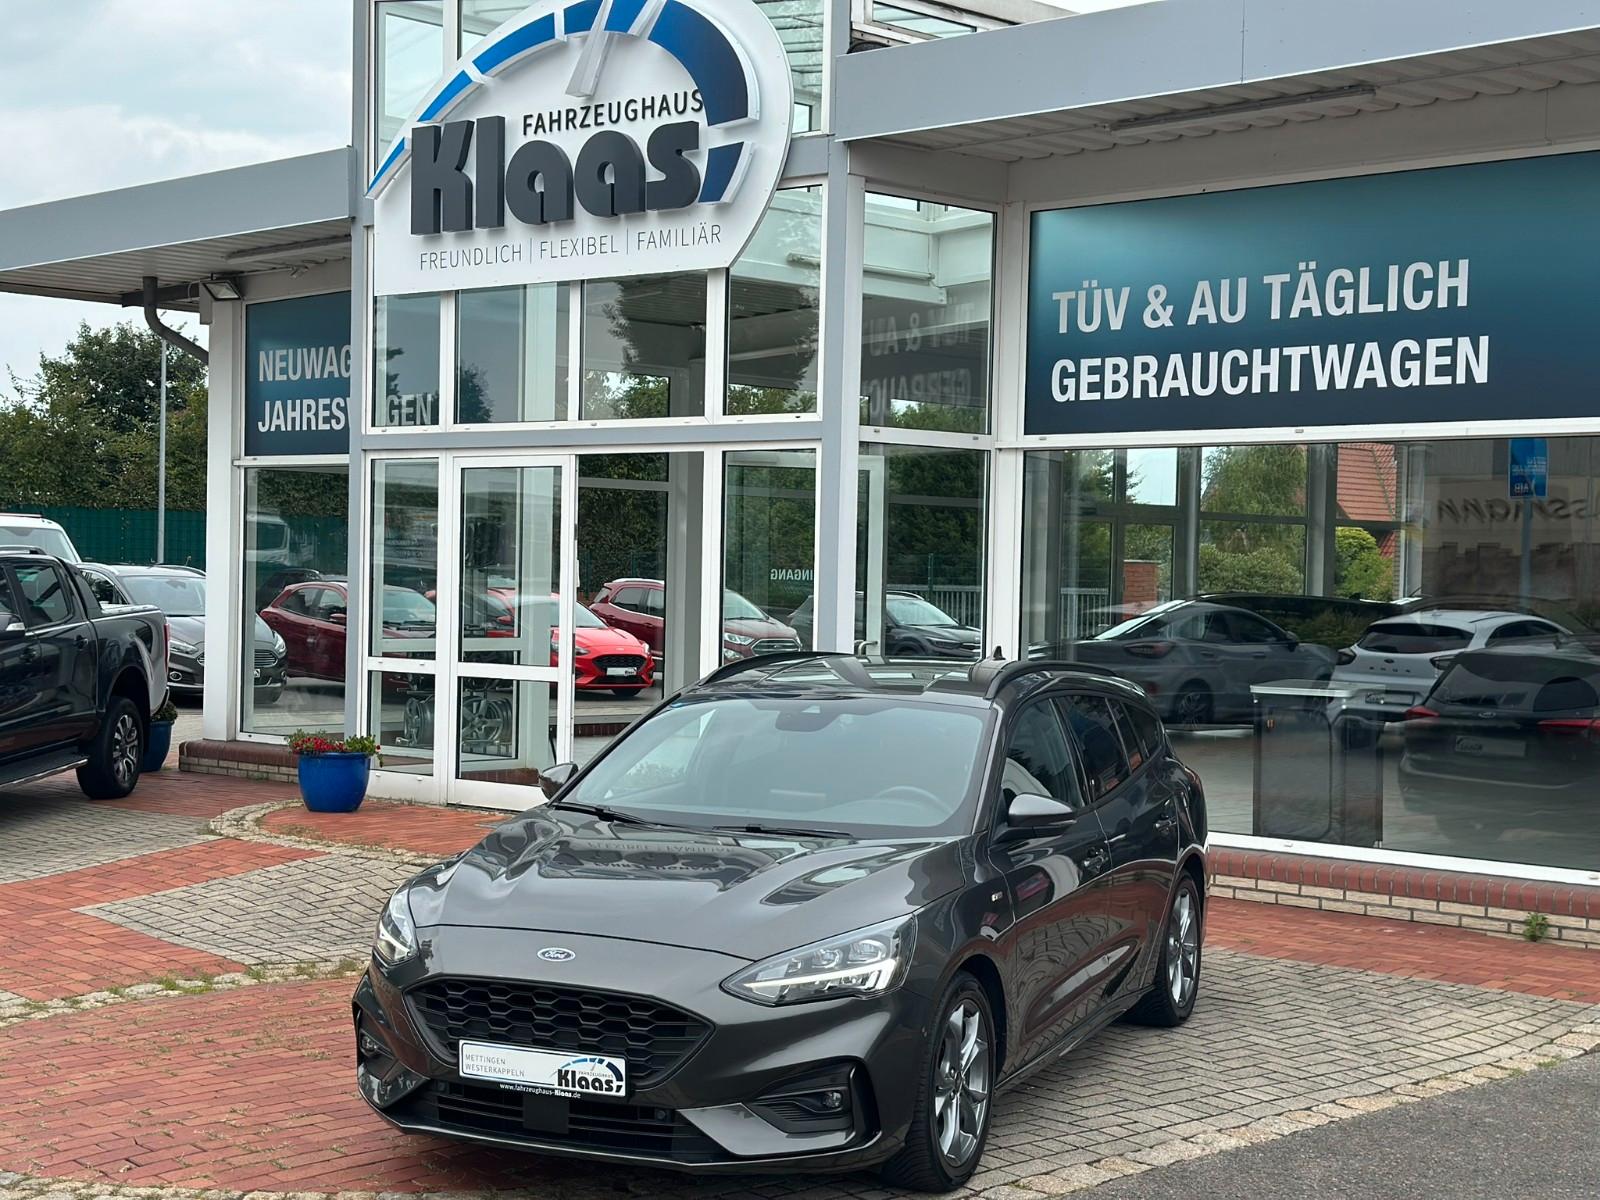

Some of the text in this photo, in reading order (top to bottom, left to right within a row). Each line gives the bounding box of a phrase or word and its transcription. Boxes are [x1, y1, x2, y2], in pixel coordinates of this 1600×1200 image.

[522, 88, 704, 136] FAHRZEUGHAUS
[410, 115, 700, 236] Klaas
[419, 223, 721, 271] FREUNDLICH FLEXIBEL FAMILIÄR
[1052, 258, 1470, 334] TÜV & AU TÄGLICH
[258, 344, 351, 382] NEUWAG
[1050, 335, 1490, 402] GEBRAUCHTWAGEN
[464, 1053, 507, 1066] METTINGEN
[464, 1063, 526, 1078] WESTERKAPPELN
[557, 1068, 614, 1093] Klaas
